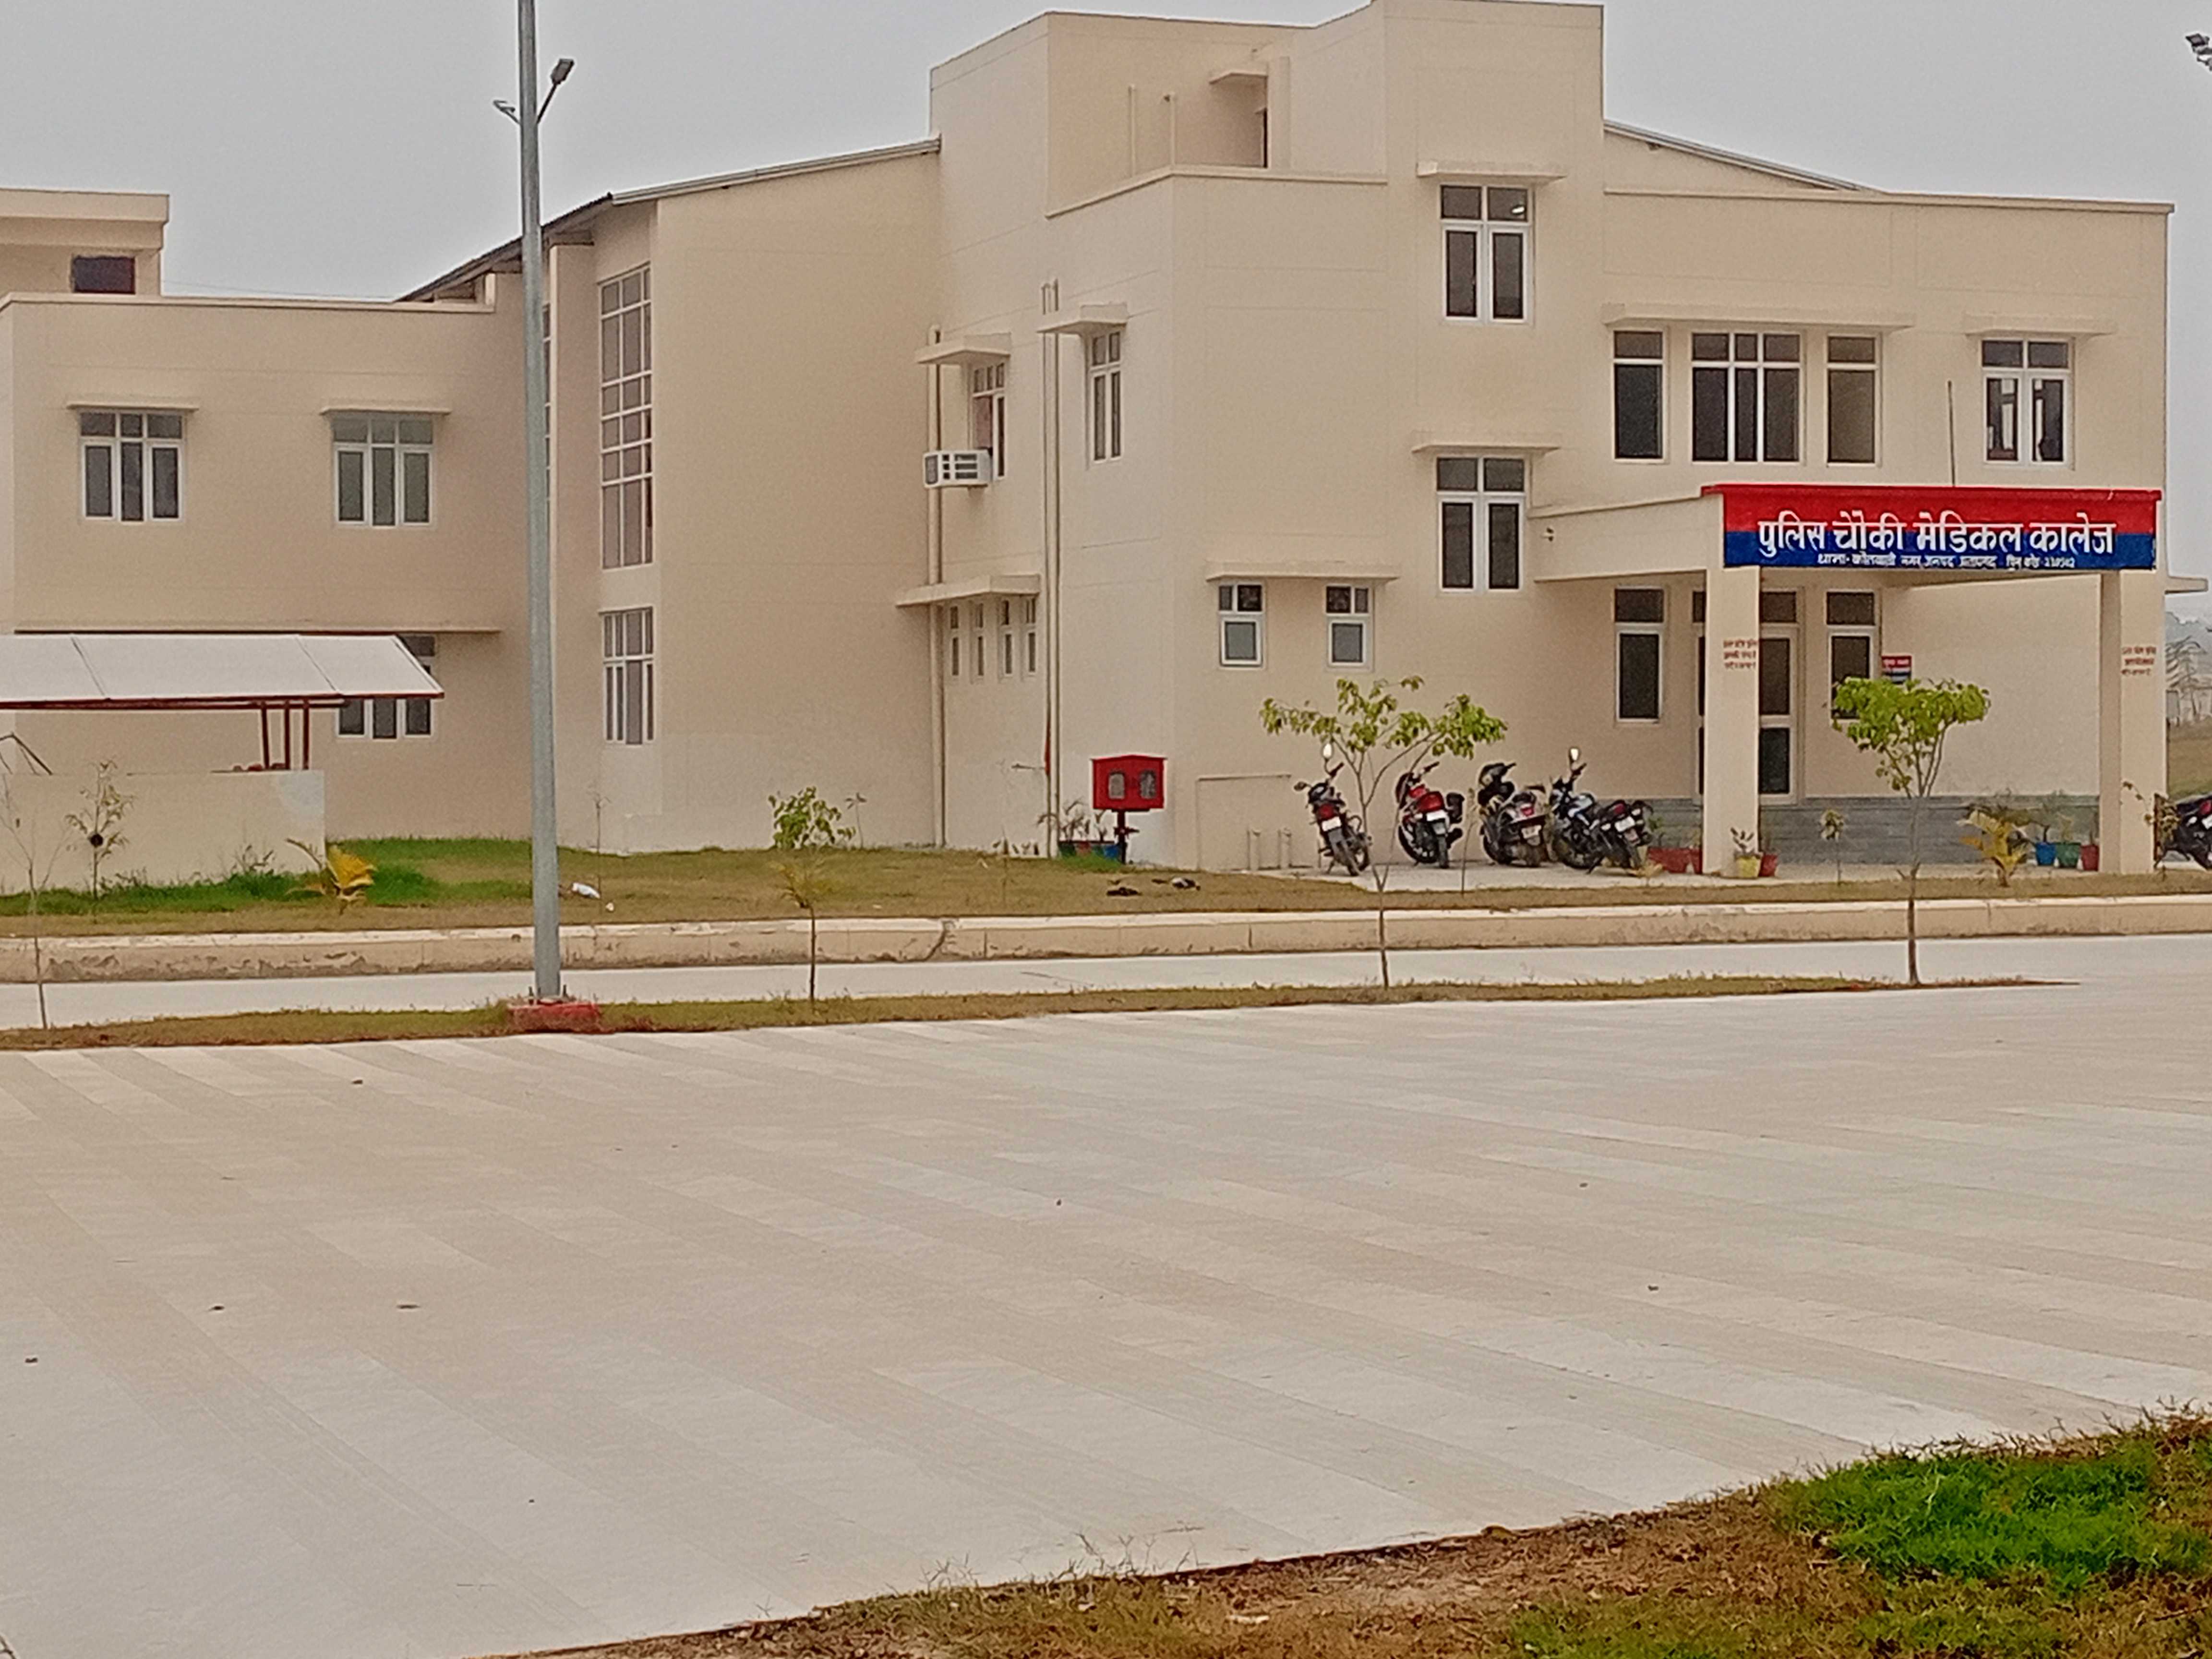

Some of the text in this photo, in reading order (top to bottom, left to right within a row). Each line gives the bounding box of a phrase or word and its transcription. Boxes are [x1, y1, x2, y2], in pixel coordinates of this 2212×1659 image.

[1757, 510, 2116, 558] पुलिस चौकी मेडिकल कालेज
